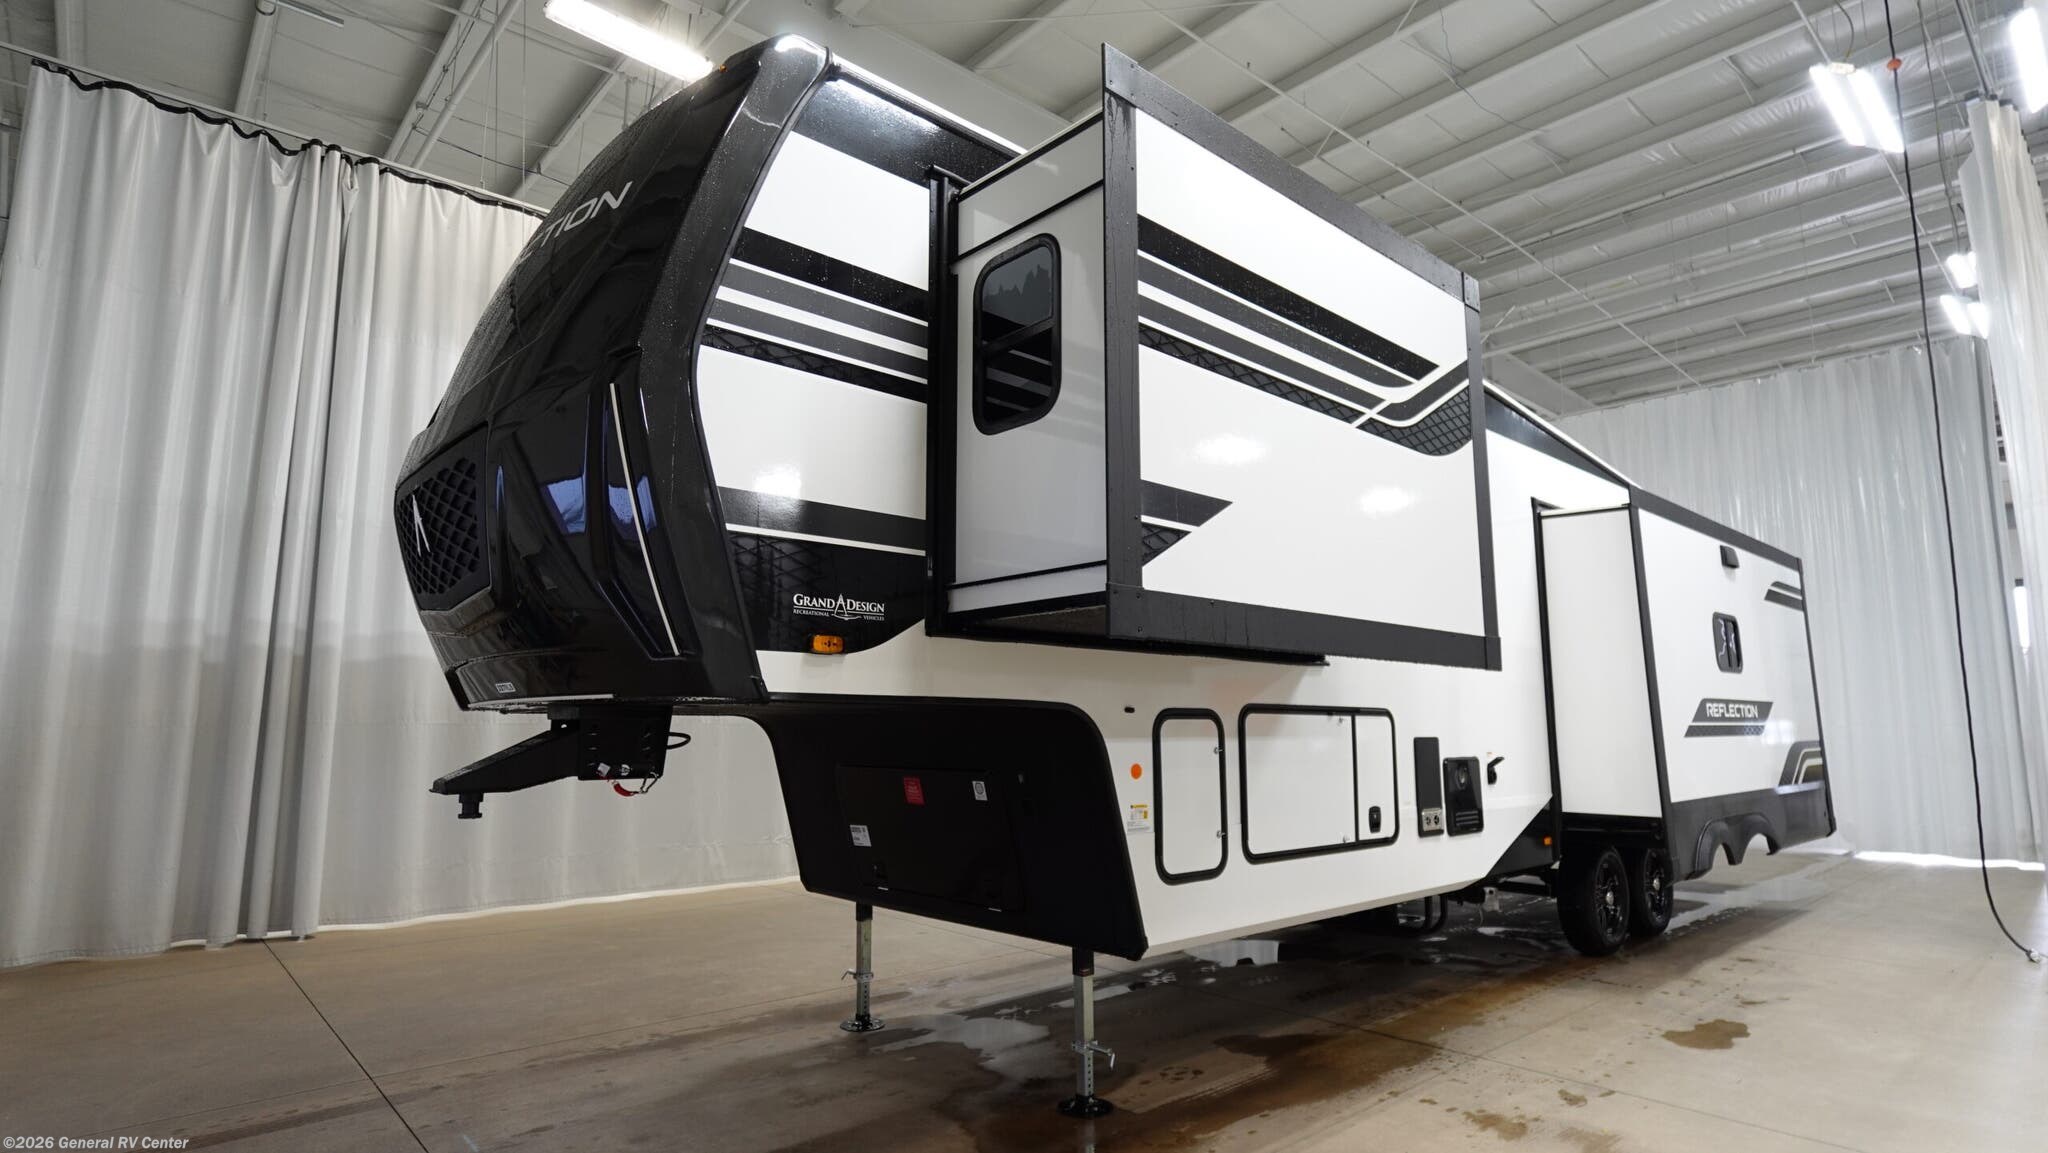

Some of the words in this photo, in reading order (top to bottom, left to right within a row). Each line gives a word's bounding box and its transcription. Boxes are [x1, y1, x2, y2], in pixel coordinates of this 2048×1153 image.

[793, 593, 836, 609] GRAND
[846, 598, 885, 613] DESIGN
[1706, 702, 1759, 718] REFLECTION
